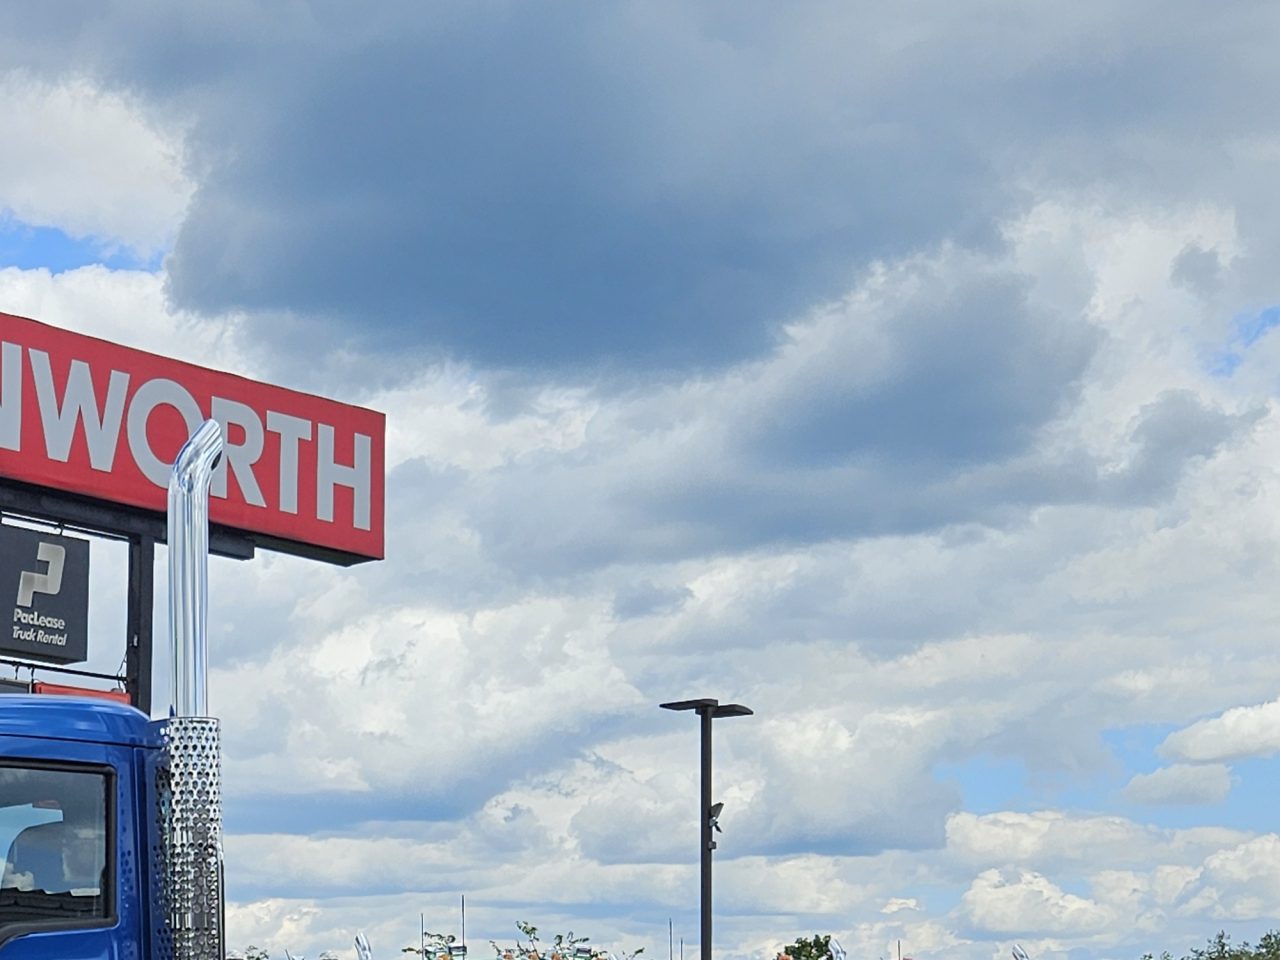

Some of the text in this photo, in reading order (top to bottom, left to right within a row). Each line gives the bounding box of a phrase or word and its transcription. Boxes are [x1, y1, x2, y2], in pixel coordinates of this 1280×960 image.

[13, 608, 65, 629] PacLease
[12, 626, 68, 646] Truck Rental
